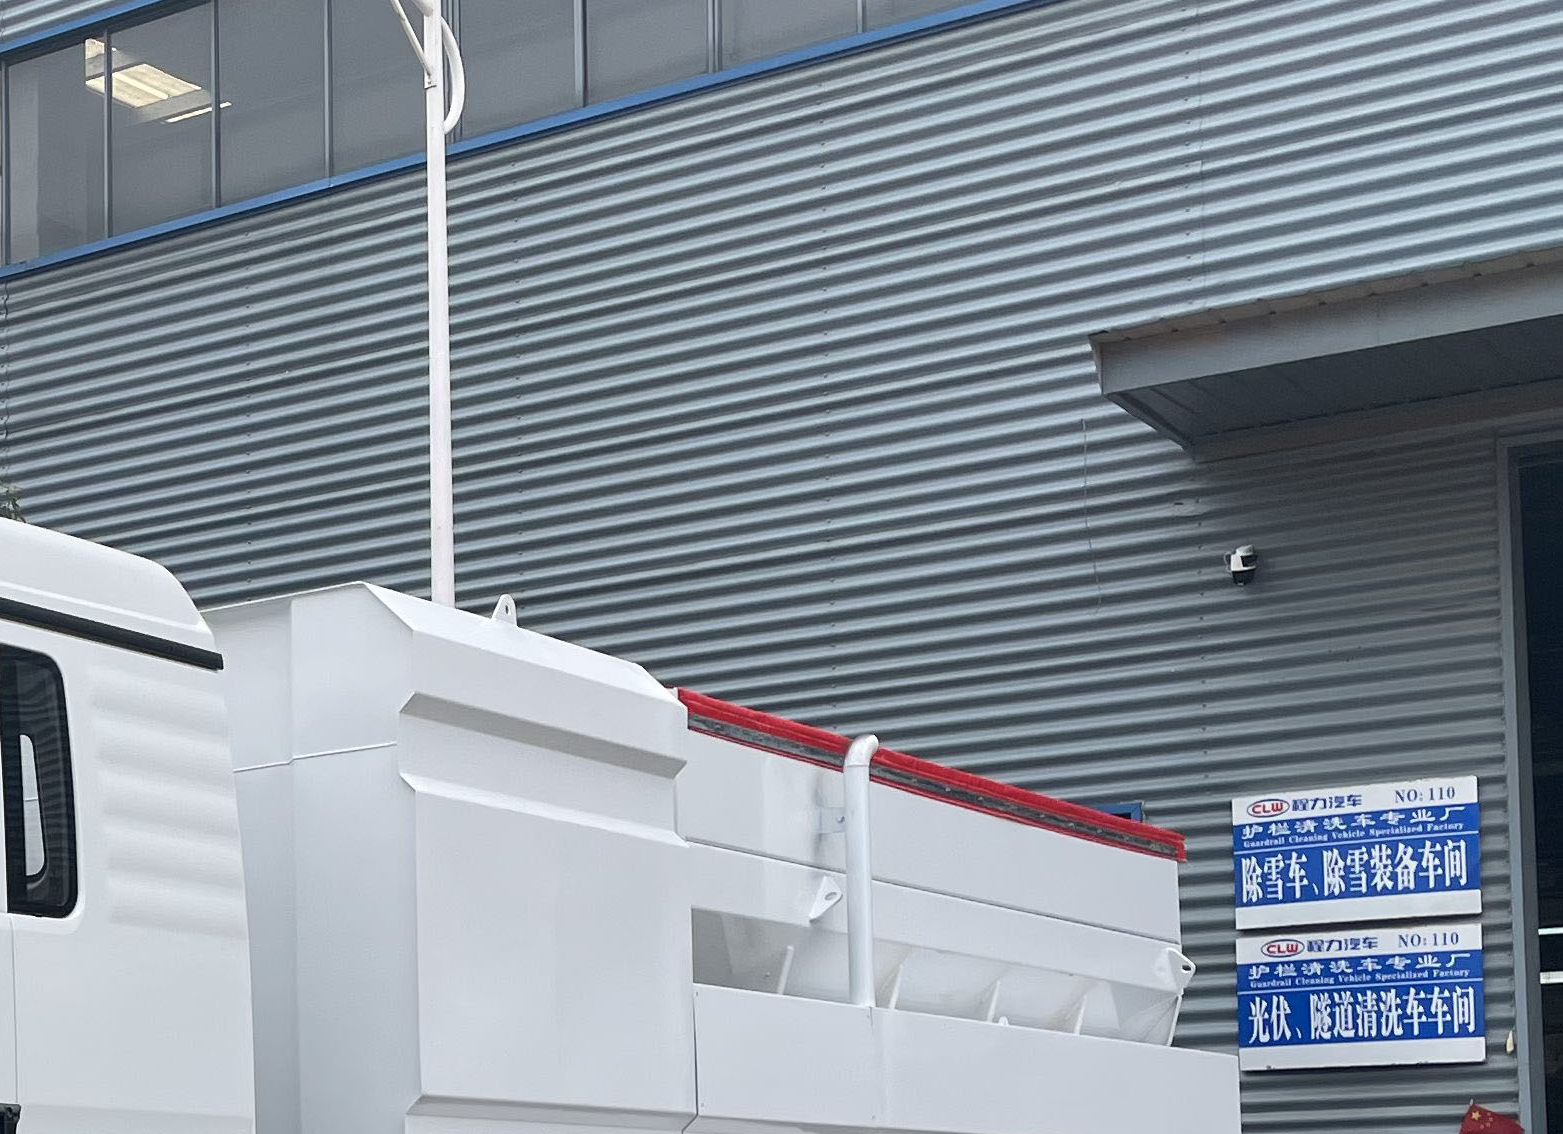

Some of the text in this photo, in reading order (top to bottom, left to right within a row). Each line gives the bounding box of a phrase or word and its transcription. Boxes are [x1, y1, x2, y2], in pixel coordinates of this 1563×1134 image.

[1251, 802, 1284, 814] CLW
[1243, 837, 1285, 848] Guardrail
[1288, 833, 1328, 844] Cleaning
[1332, 830, 1365, 840] Vehicle
[1427, 822, 1464, 832] Factory
[1241, 838, 1467, 903] 除雪车、除雪装备车间
[1266, 943, 1298, 954] CLW
[1250, 978, 1292, 988] Guardrail
[1295, 976, 1335, 985] Cleaning
[1248, 985, 1476, 1045] 光伏、隧道清洗车车间
